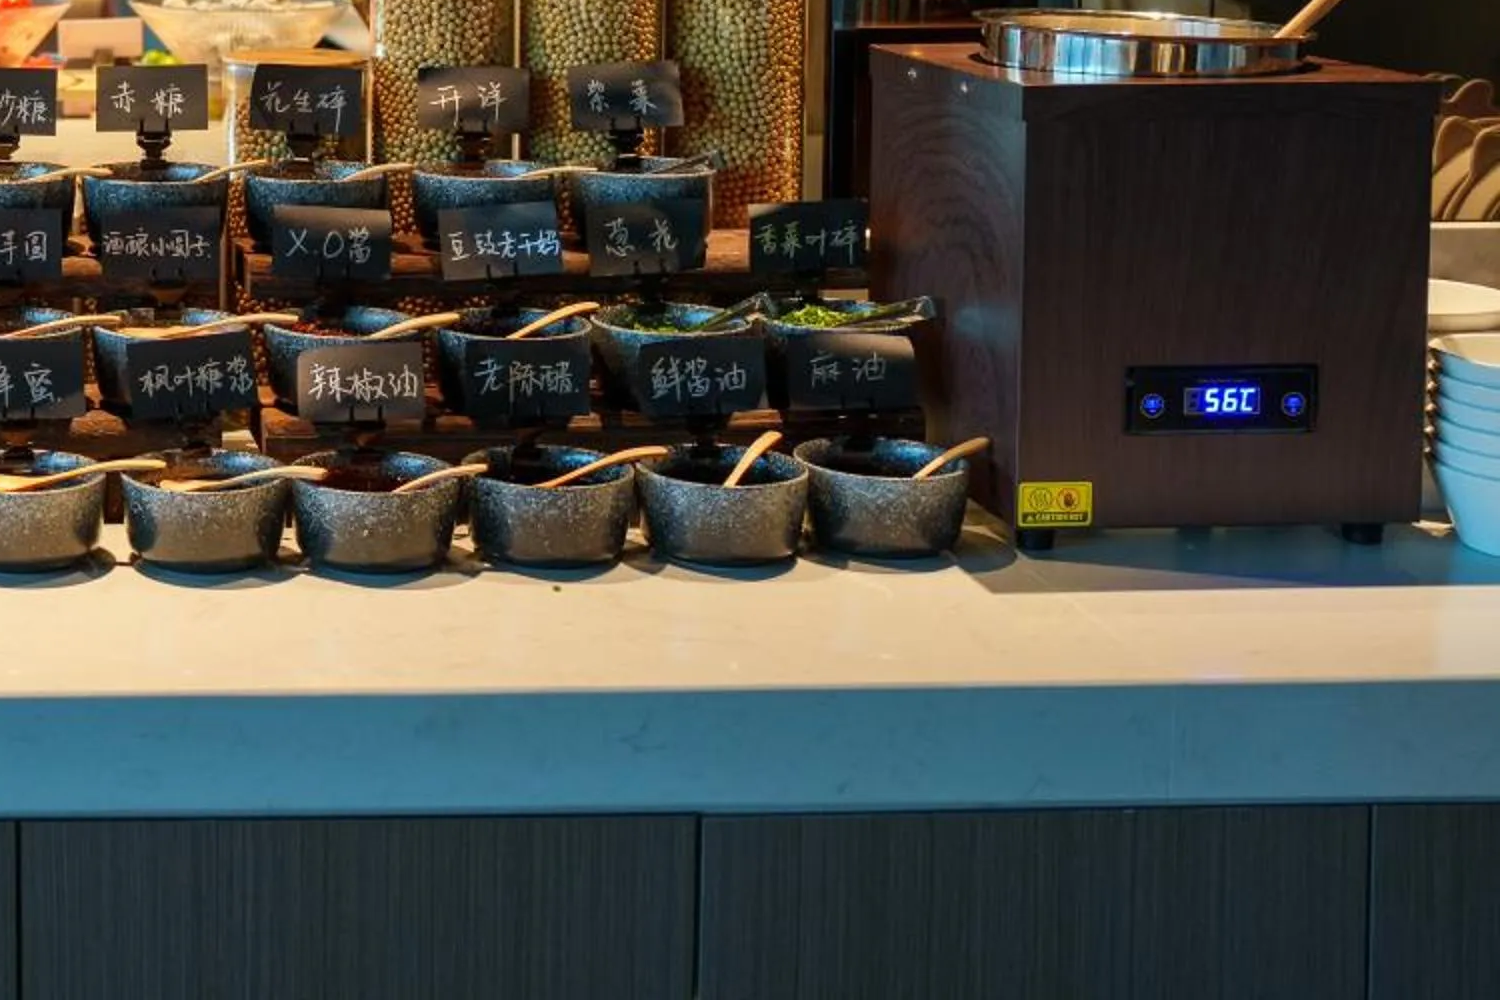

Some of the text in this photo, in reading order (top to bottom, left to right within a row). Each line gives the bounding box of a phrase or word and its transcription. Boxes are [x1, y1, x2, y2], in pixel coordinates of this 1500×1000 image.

[111, 82, 186, 118] 赤糖
[259, 81, 348, 132] 花生碎
[431, 81, 506, 127] 开洋
[587, 79, 659, 115] 紫菜
[448, 229, 561, 262] 豆豉老干妈
[604, 217, 680, 258] 葱花
[755, 219, 861, 264] 香菜叶碎
[139, 355, 254, 395] 枫叶糖浆
[308, 363, 418, 403] 辣椒油
[651, 355, 747, 402] 鲜酱油
[810, 350, 887, 389] 麻油
